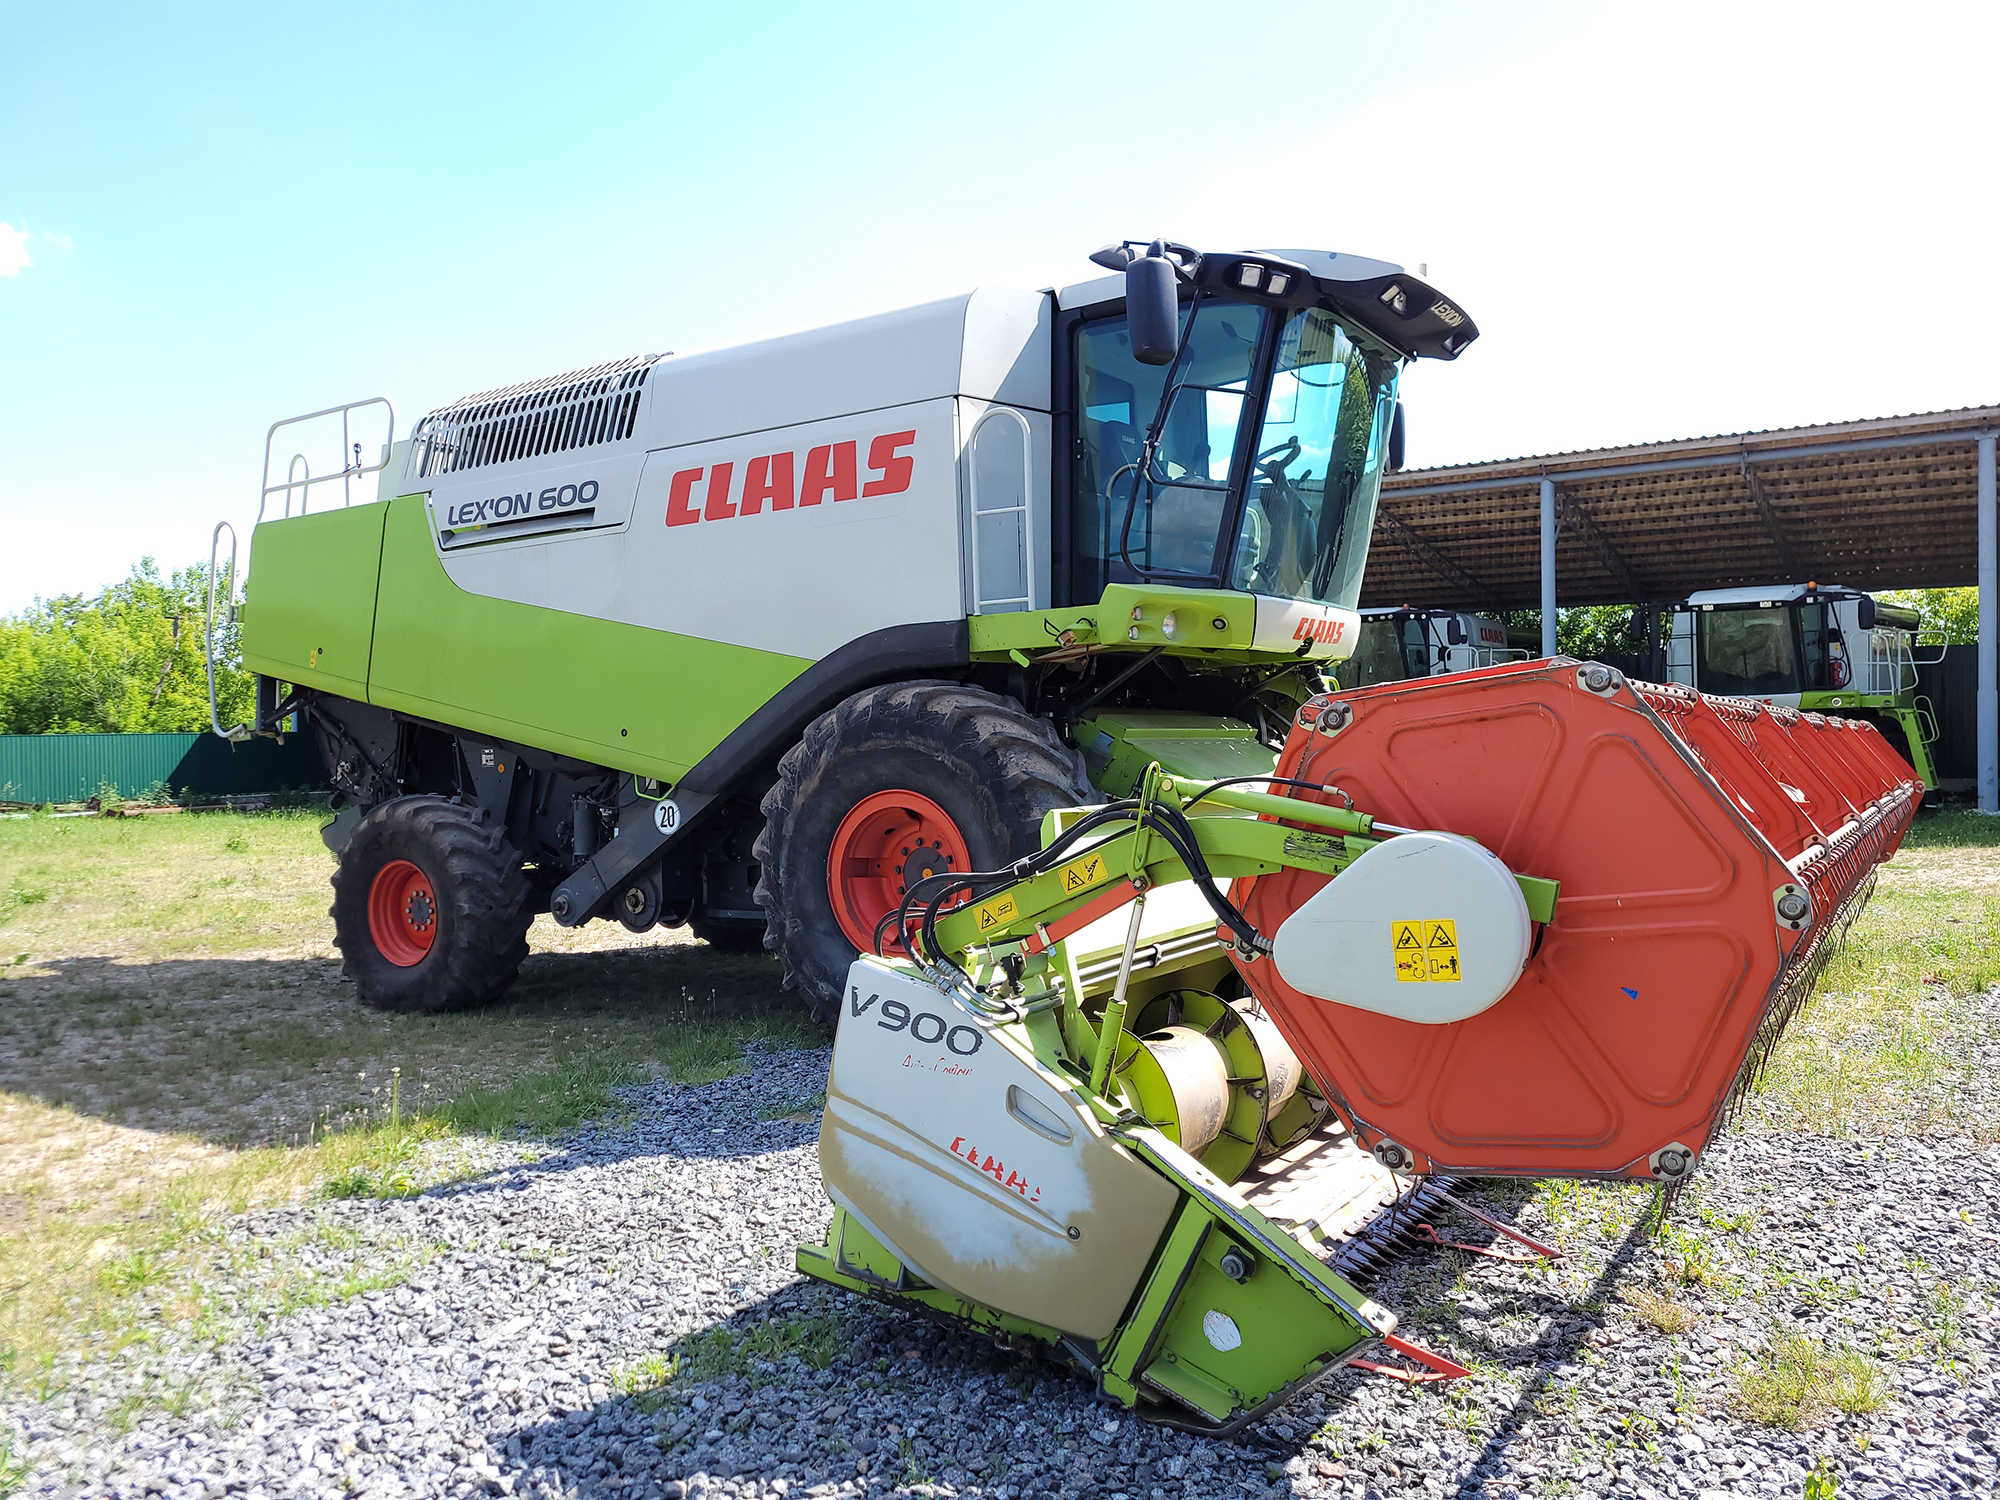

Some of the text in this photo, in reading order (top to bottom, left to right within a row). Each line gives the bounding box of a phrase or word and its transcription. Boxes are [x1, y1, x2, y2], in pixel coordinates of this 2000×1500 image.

[1430, 300, 1465, 327] LEXION
[665, 429, 917, 528] CLAAS
[538, 480, 599, 511] 600
[660, 805, 675, 828] 20
[851, 985, 983, 1056] V 900
